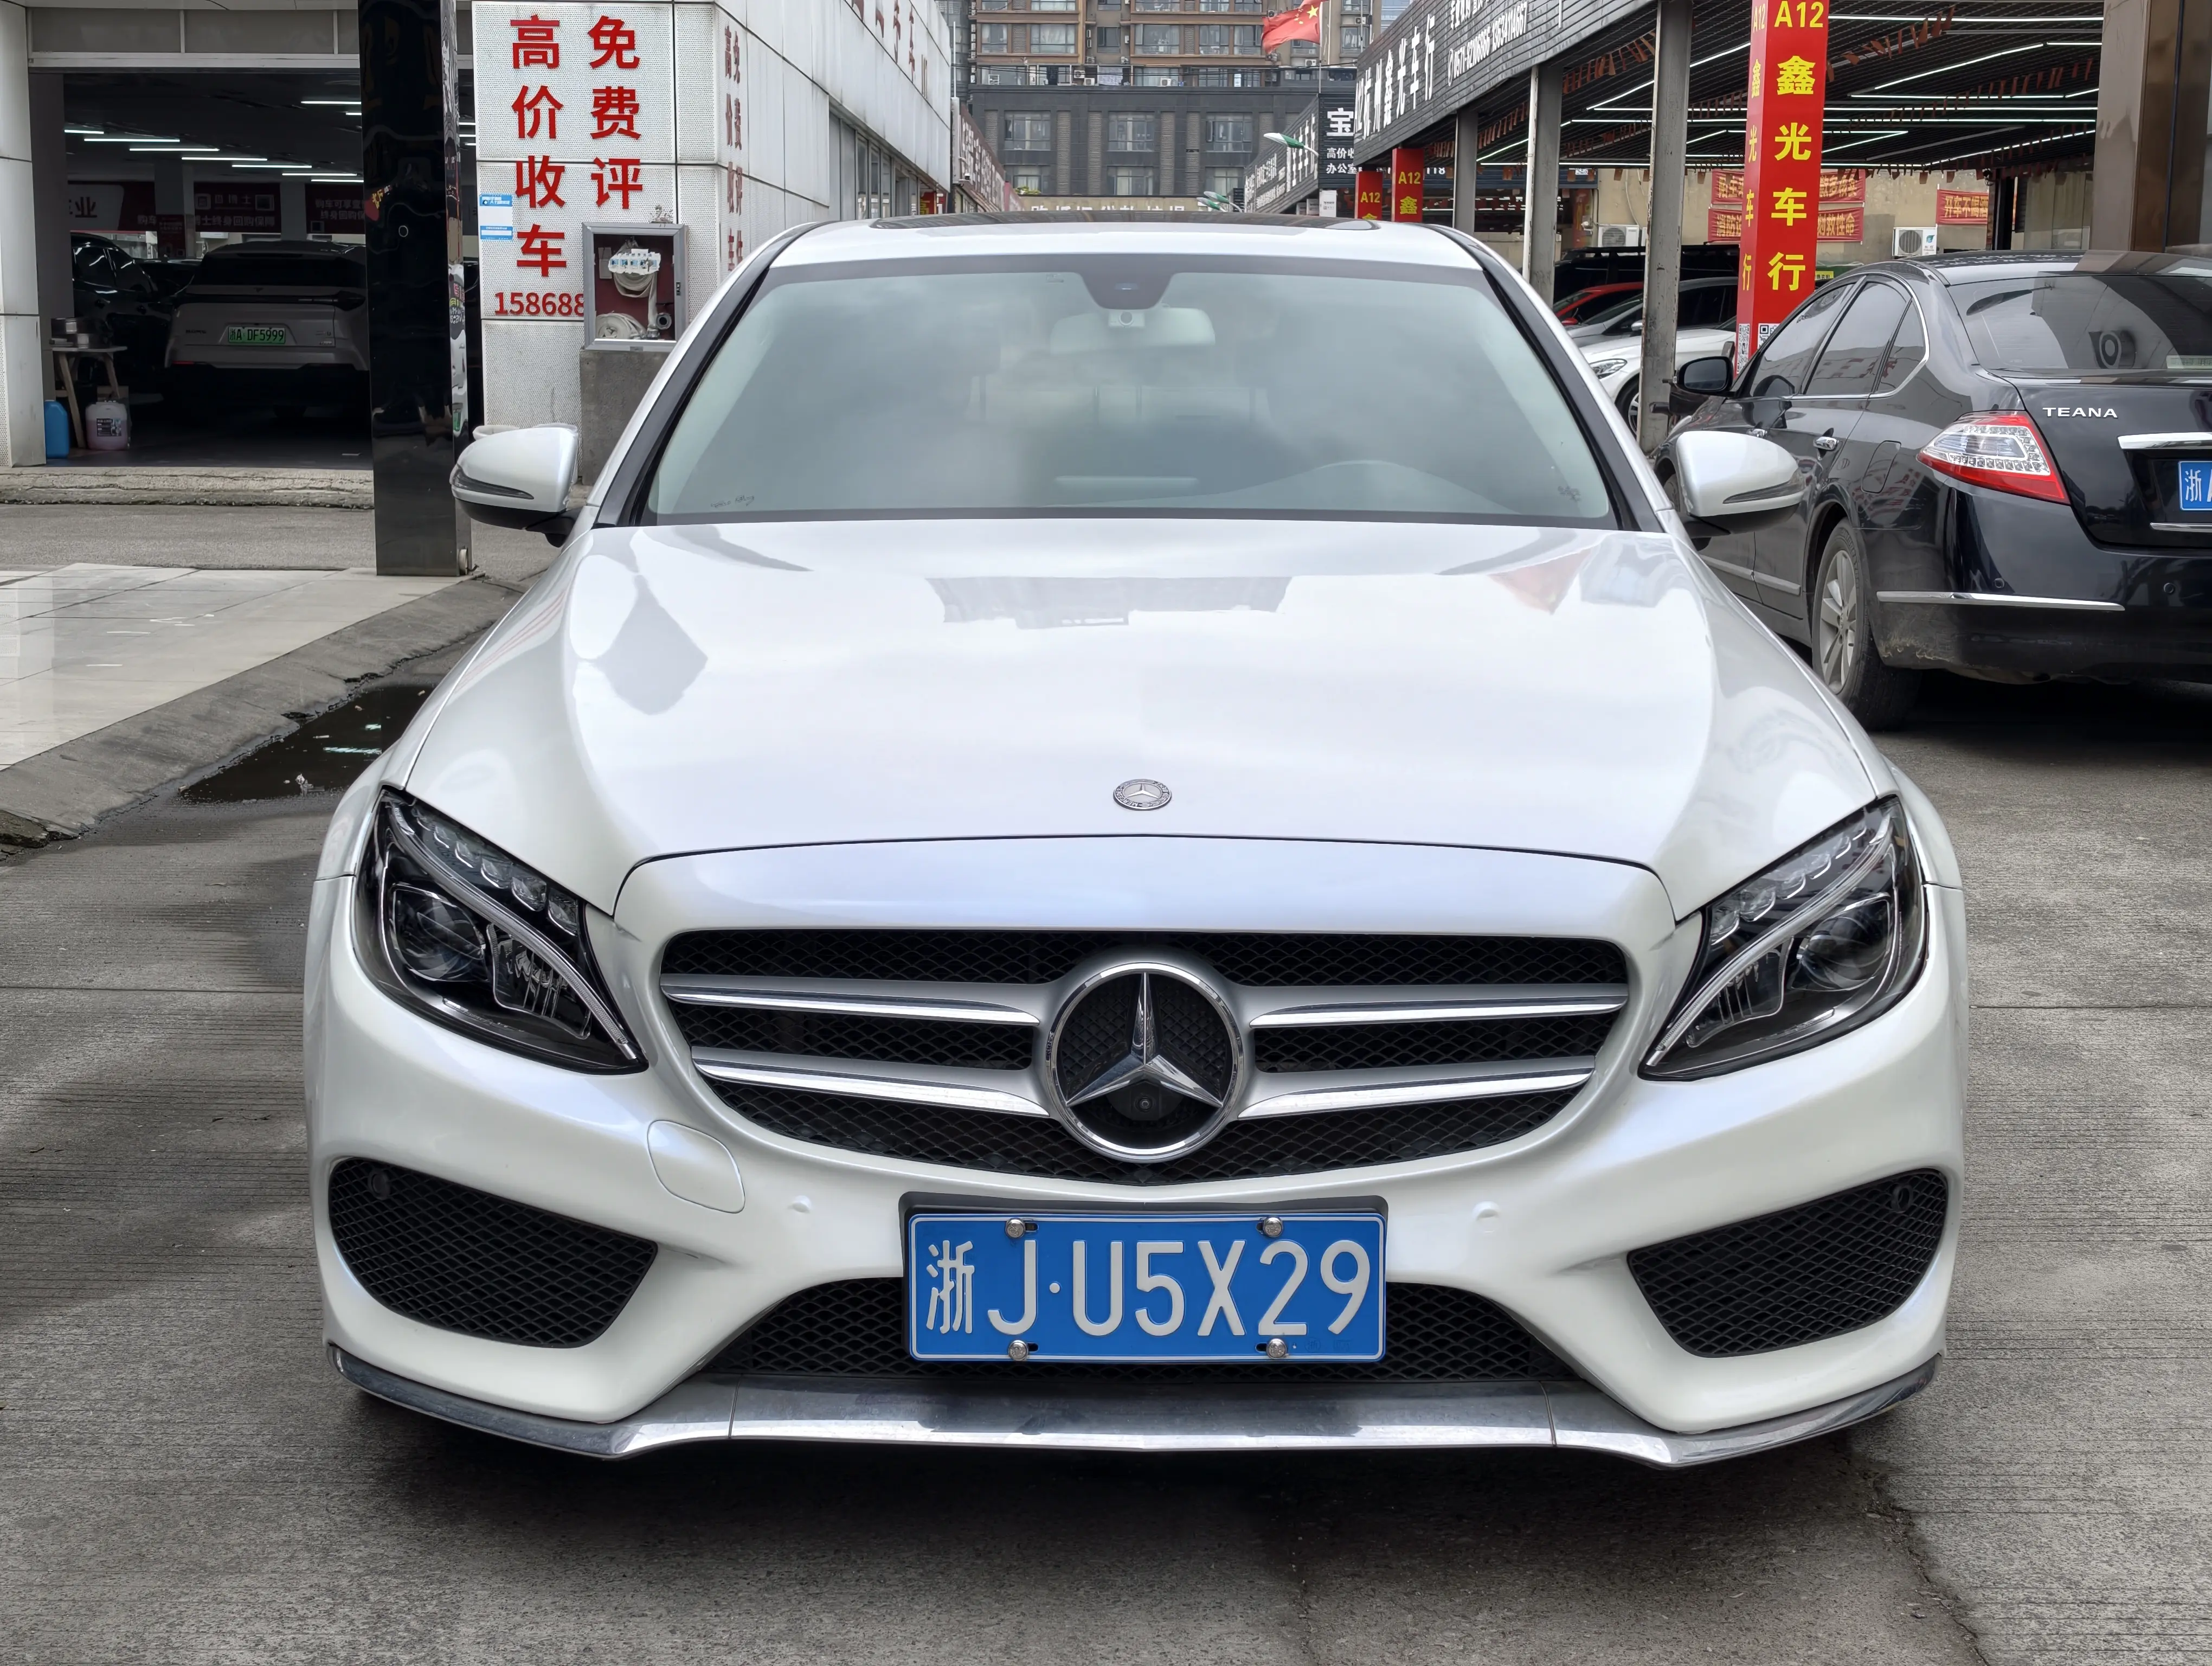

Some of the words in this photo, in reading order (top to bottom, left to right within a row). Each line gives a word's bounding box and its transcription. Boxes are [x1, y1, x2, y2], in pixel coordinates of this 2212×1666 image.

[1753, 3, 1765, 33] A12
[1774, 1, 1823, 28] A12
[587, 15, 643, 210] 免费评
[1327, 108, 1354, 136] 宝
[511, 15, 568, 277] 高价收车
[1398, 171, 1421, 184] A12
[1767, 56, 1816, 291] 鑫光车行
[1360, 191, 1380, 203] A12
[2043, 407, 2118, 418] TEANA
